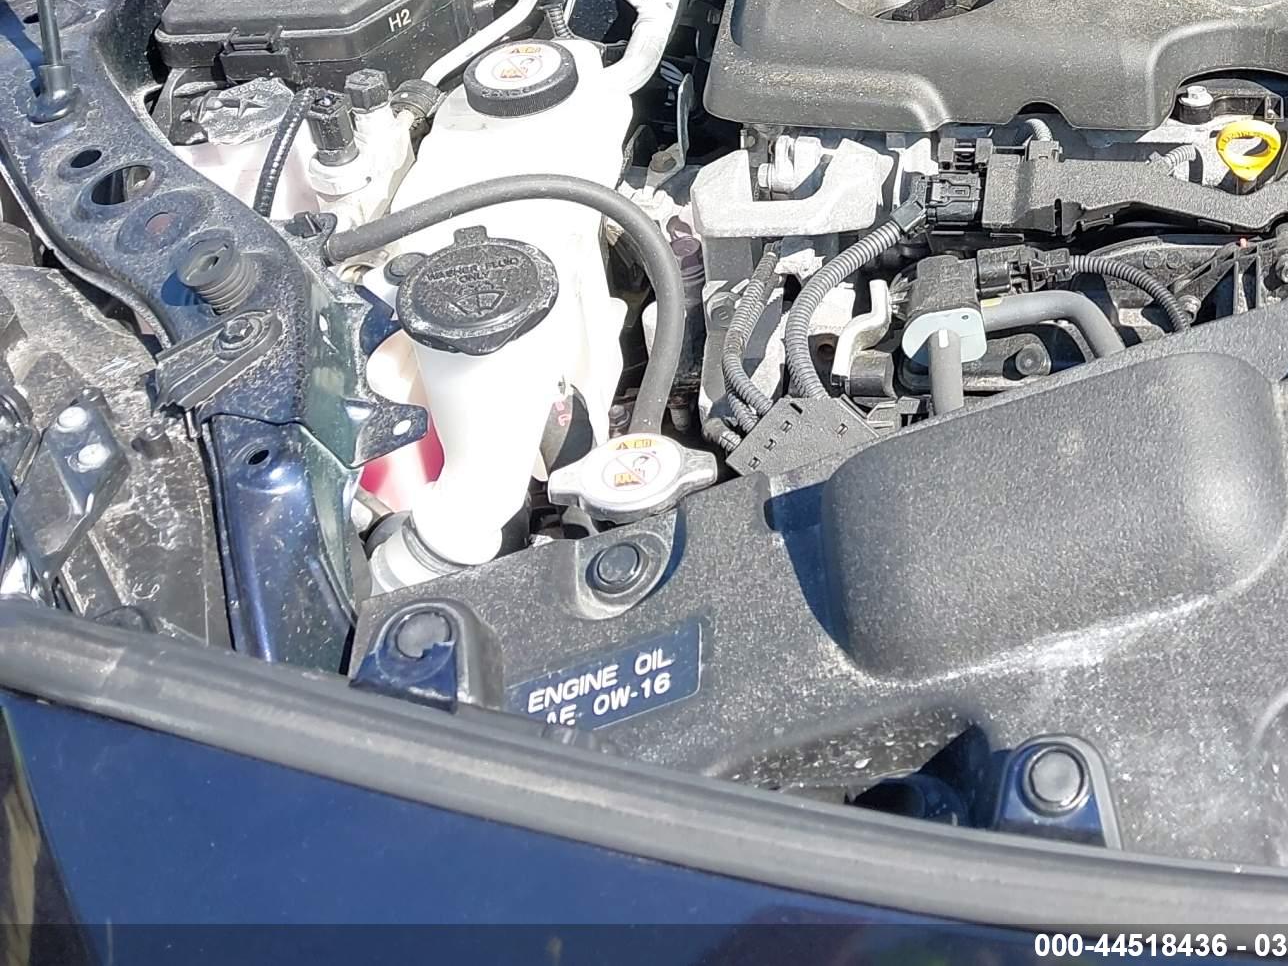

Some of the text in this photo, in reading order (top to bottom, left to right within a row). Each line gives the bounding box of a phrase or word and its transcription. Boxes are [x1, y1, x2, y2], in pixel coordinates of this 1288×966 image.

[388, 9, 412, 32] H2
[458, 270, 490, 284] ONLY
[527, 648, 673, 714] ENGINE OIL
[592, 672, 672, 716] 0W-16
